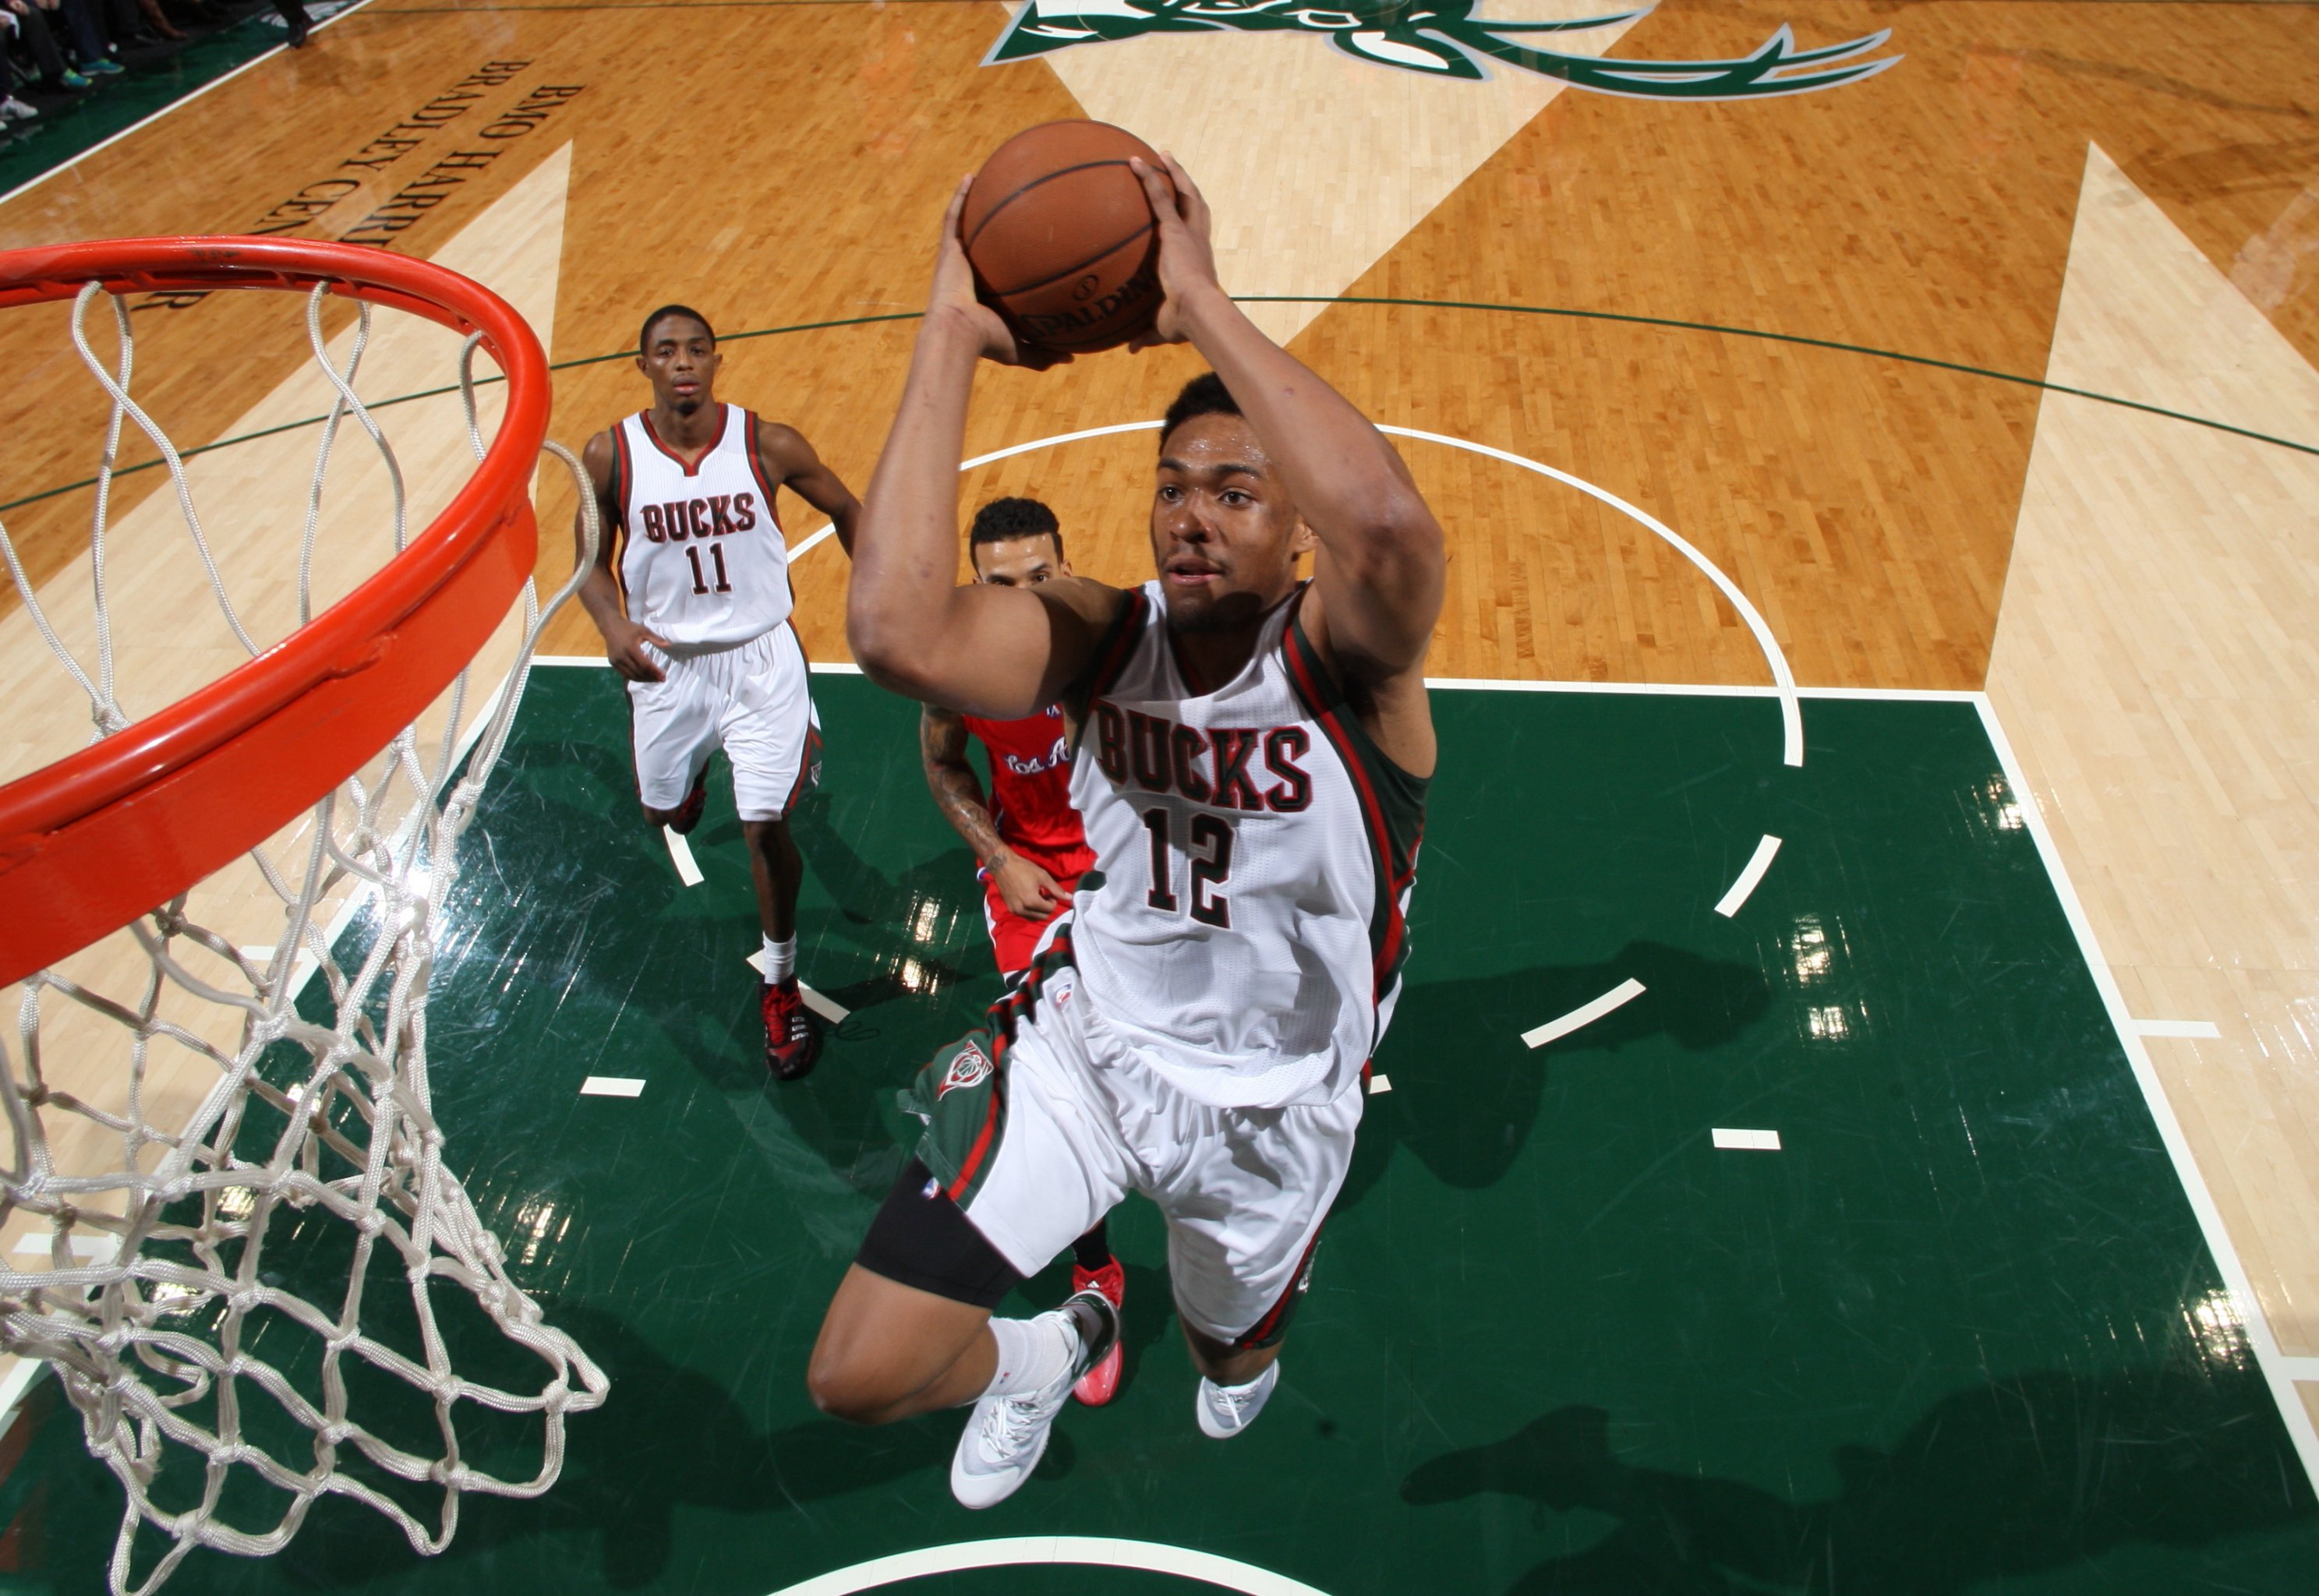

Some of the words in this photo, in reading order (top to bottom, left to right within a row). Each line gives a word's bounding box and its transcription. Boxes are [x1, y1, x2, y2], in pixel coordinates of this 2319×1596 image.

[338, 58, 535, 172] BRADLEY
[478, 84, 588, 139] BMO
[337, 150, 504, 249] HARRI
[640, 492, 756, 543] BUCKS
[684, 542, 733, 595] 11
[1005, 754, 1045, 775] Los
[1095, 701, 1313, 813] BUCKS
[1144, 807, 1232, 929] 12
